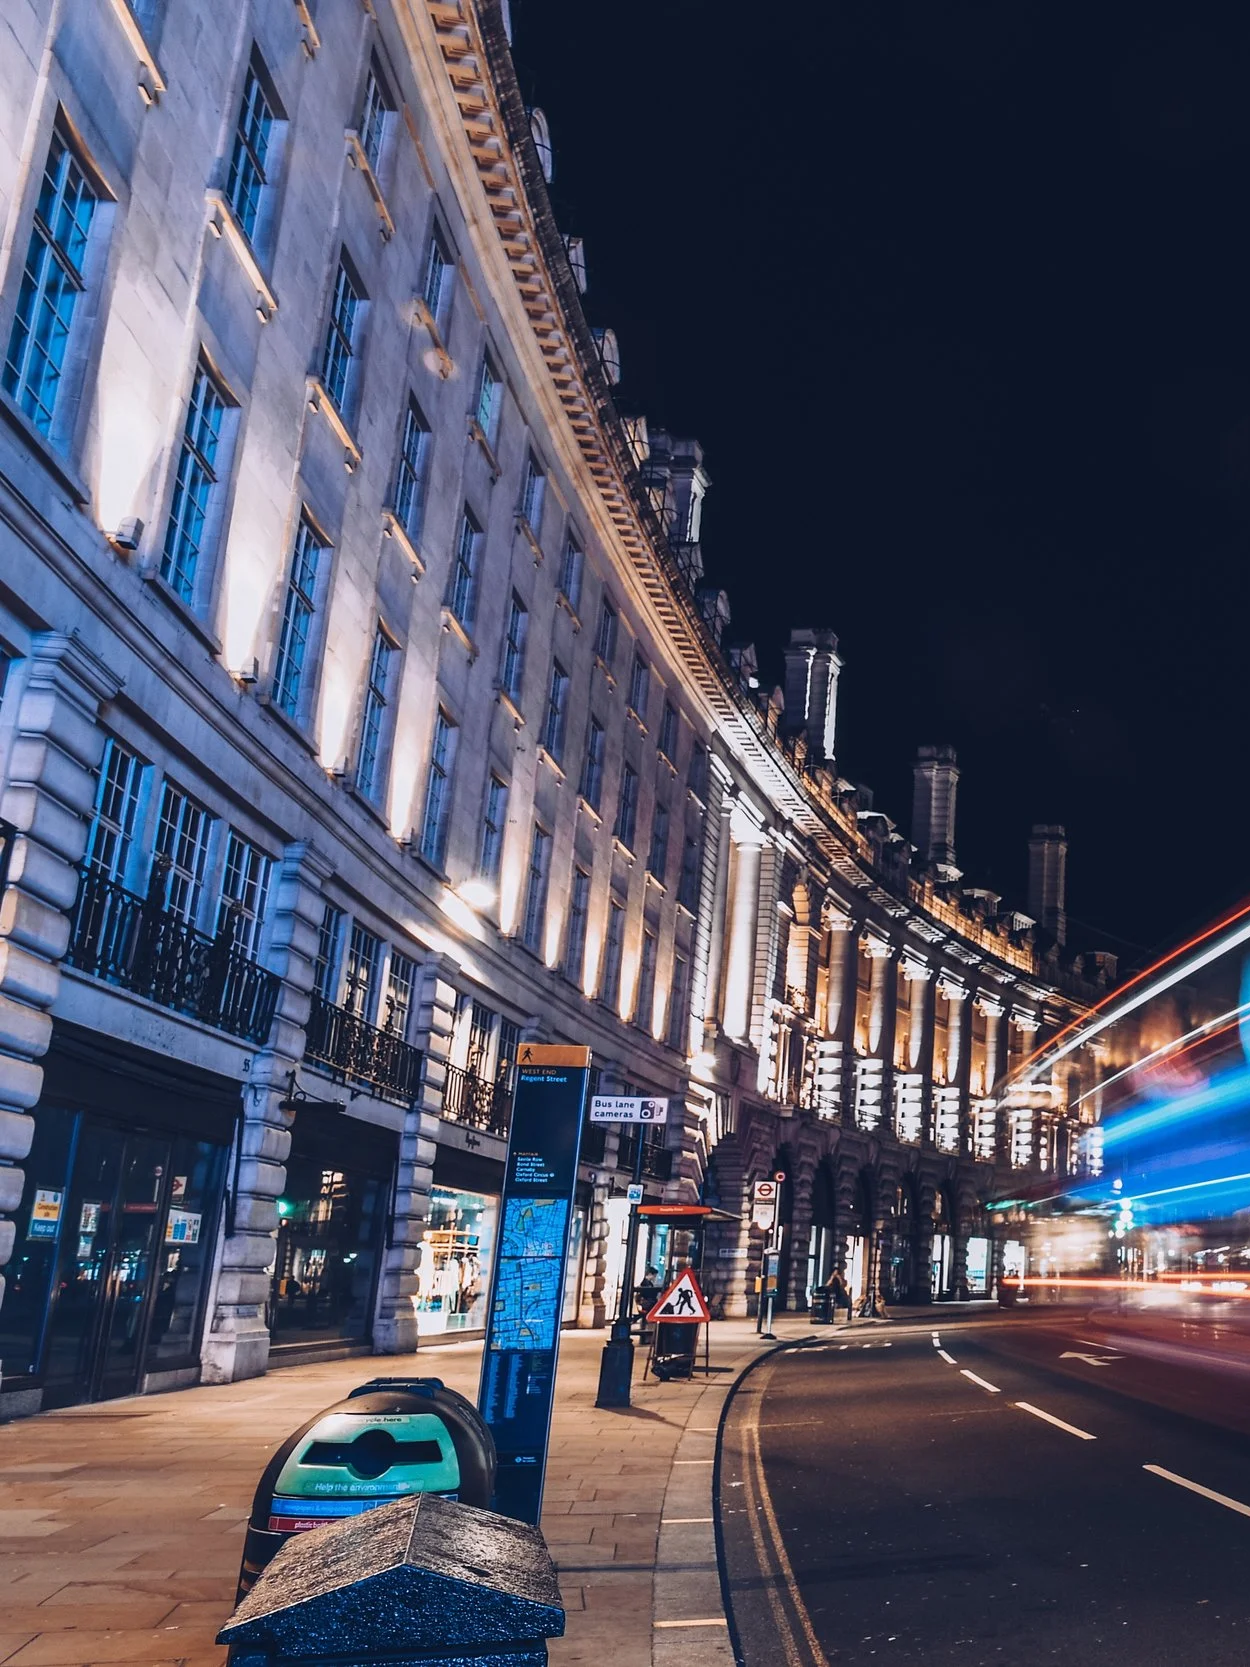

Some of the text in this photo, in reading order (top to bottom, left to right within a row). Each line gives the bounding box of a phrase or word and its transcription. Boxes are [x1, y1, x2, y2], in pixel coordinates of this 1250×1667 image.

[520, 1074, 568, 1083] Regent Street
[594, 1100, 635, 1108] Bus lane
[315, 1483, 334, 1493] Help
[334, 1483, 348, 1491] the
[294, 1521, 313, 1529] plastic
